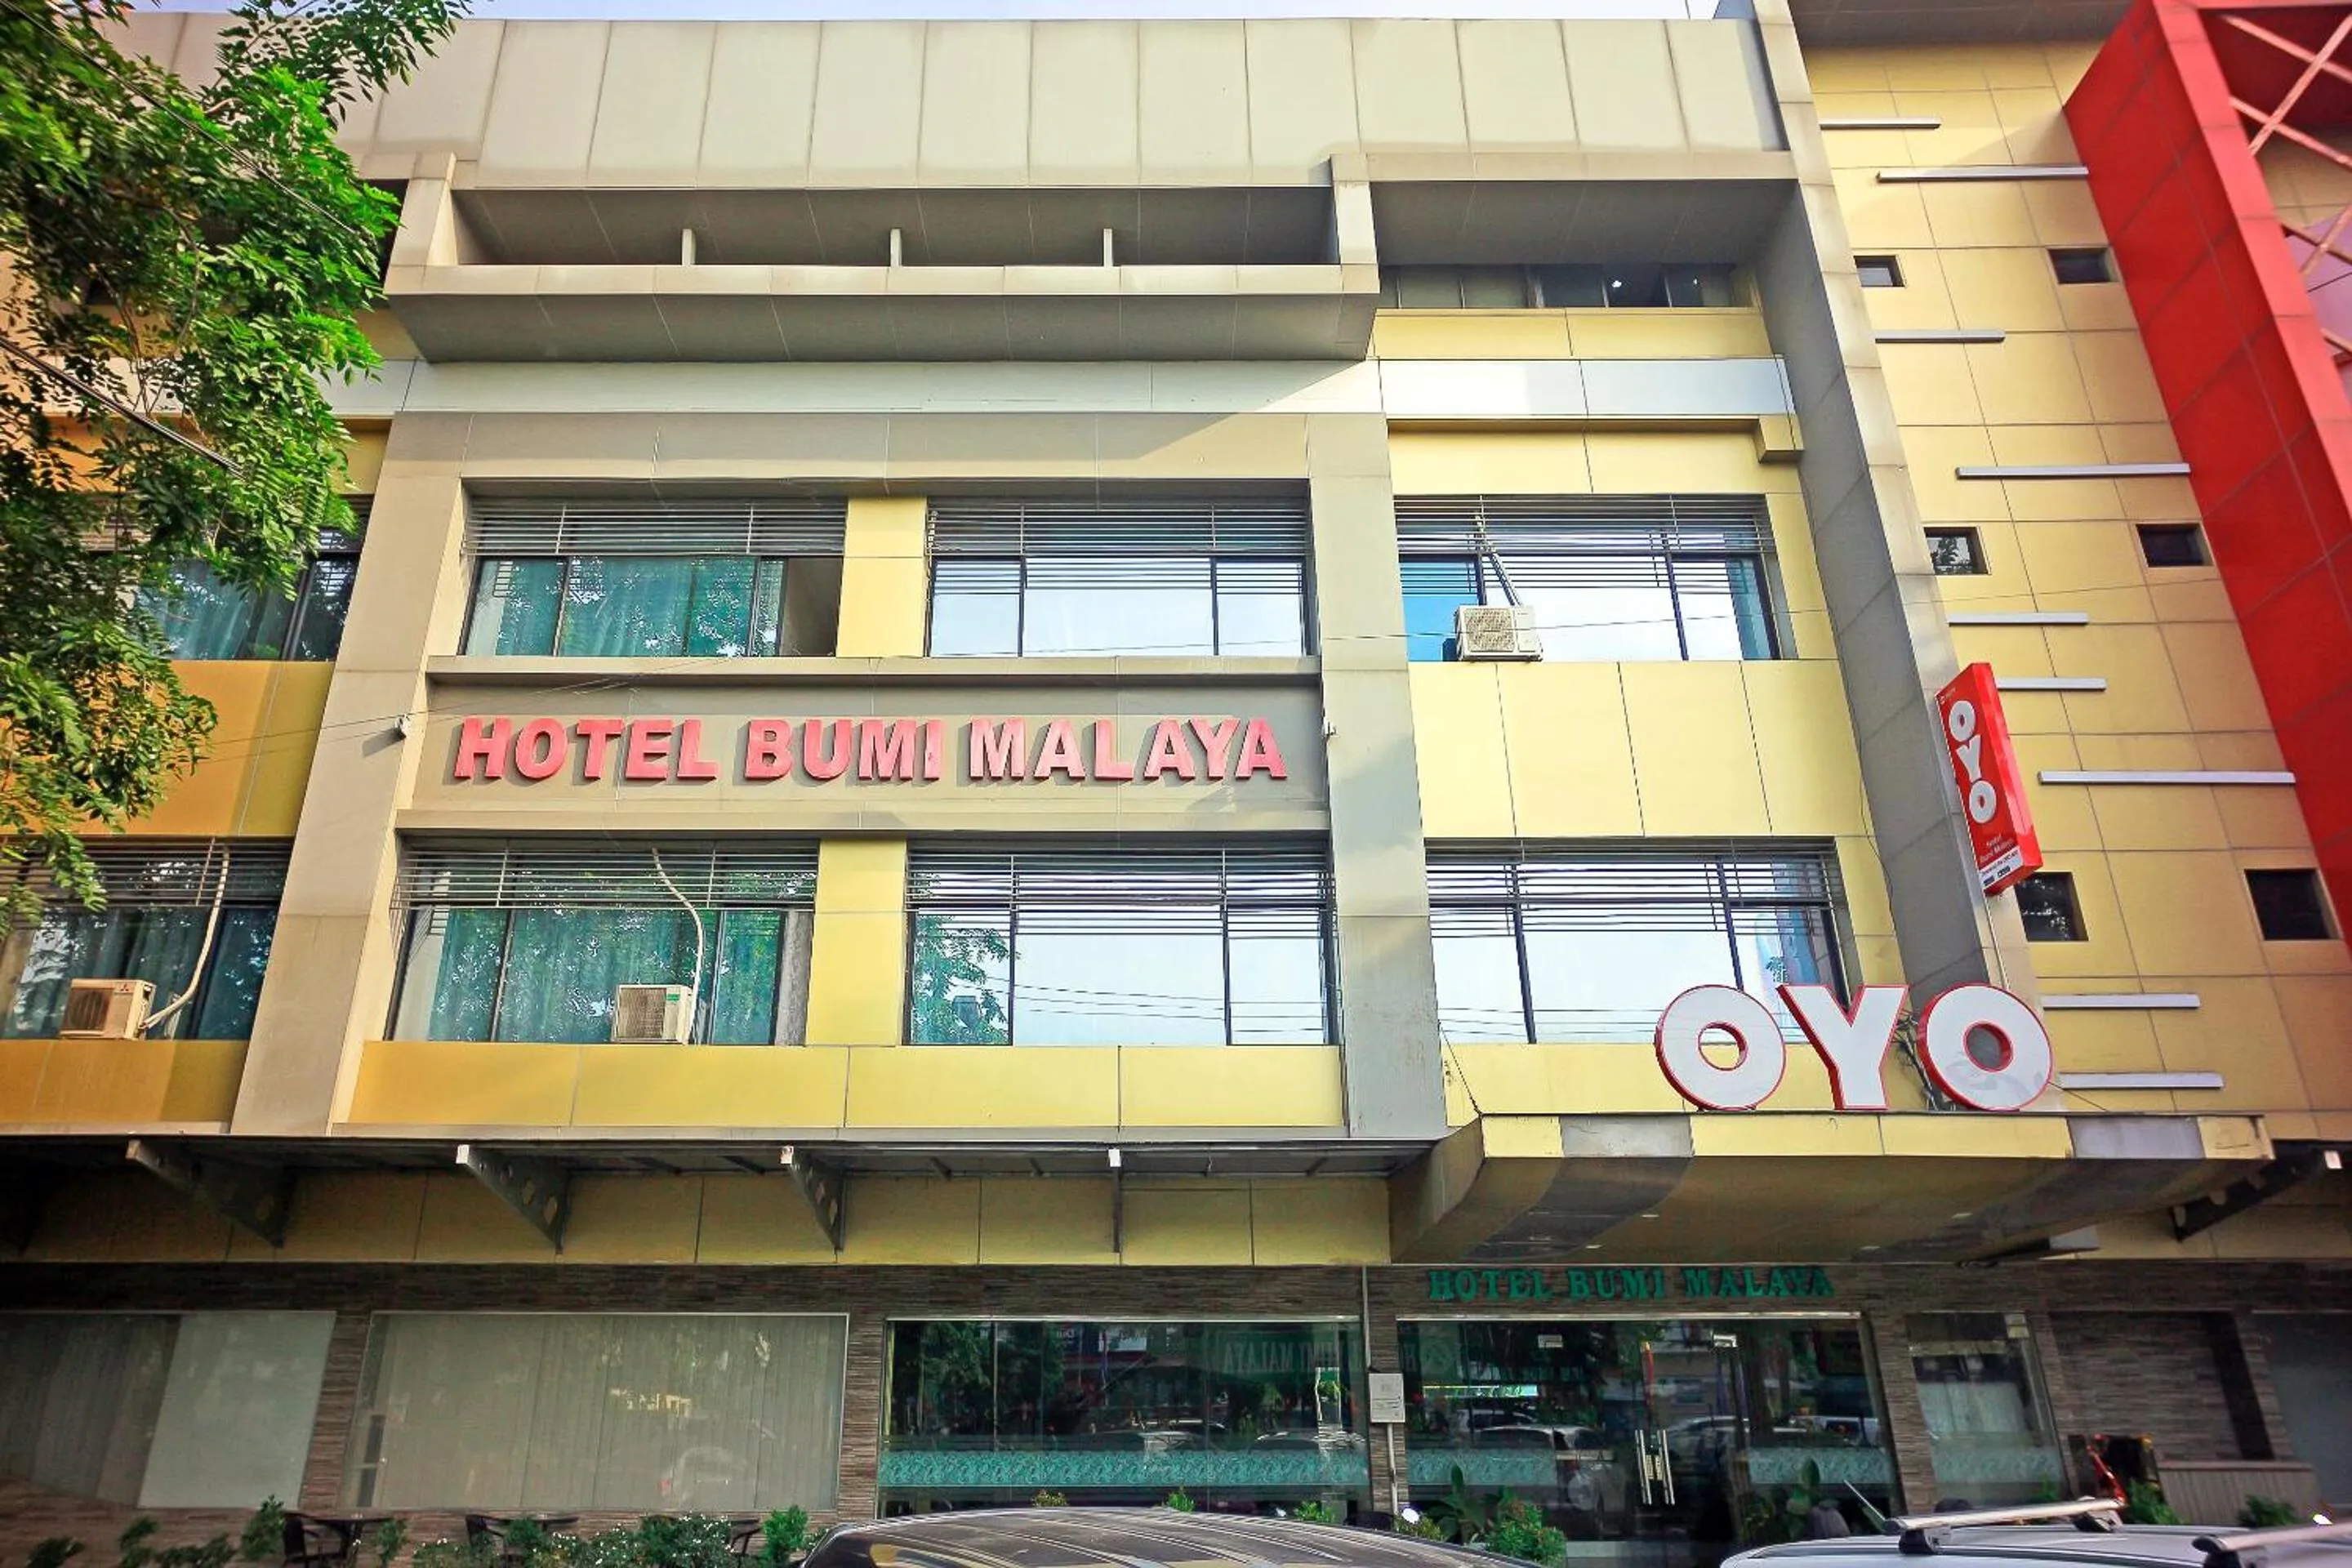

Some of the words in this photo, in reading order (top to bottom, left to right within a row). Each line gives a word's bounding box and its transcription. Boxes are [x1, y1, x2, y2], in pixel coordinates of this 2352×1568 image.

[453, 718, 720, 780] HOTEL
[744, 719, 942, 781] BUMI
[969, 718, 1288, 781] MALAYA
[1949, 700, 1998, 824] OYO
[1655, 984, 2052, 1111] OYO
[1428, 1269, 1552, 1302] HOTEL
[1566, 1269, 1664, 1300] BUMI
[1681, 1267, 1834, 1298] MALAYA
